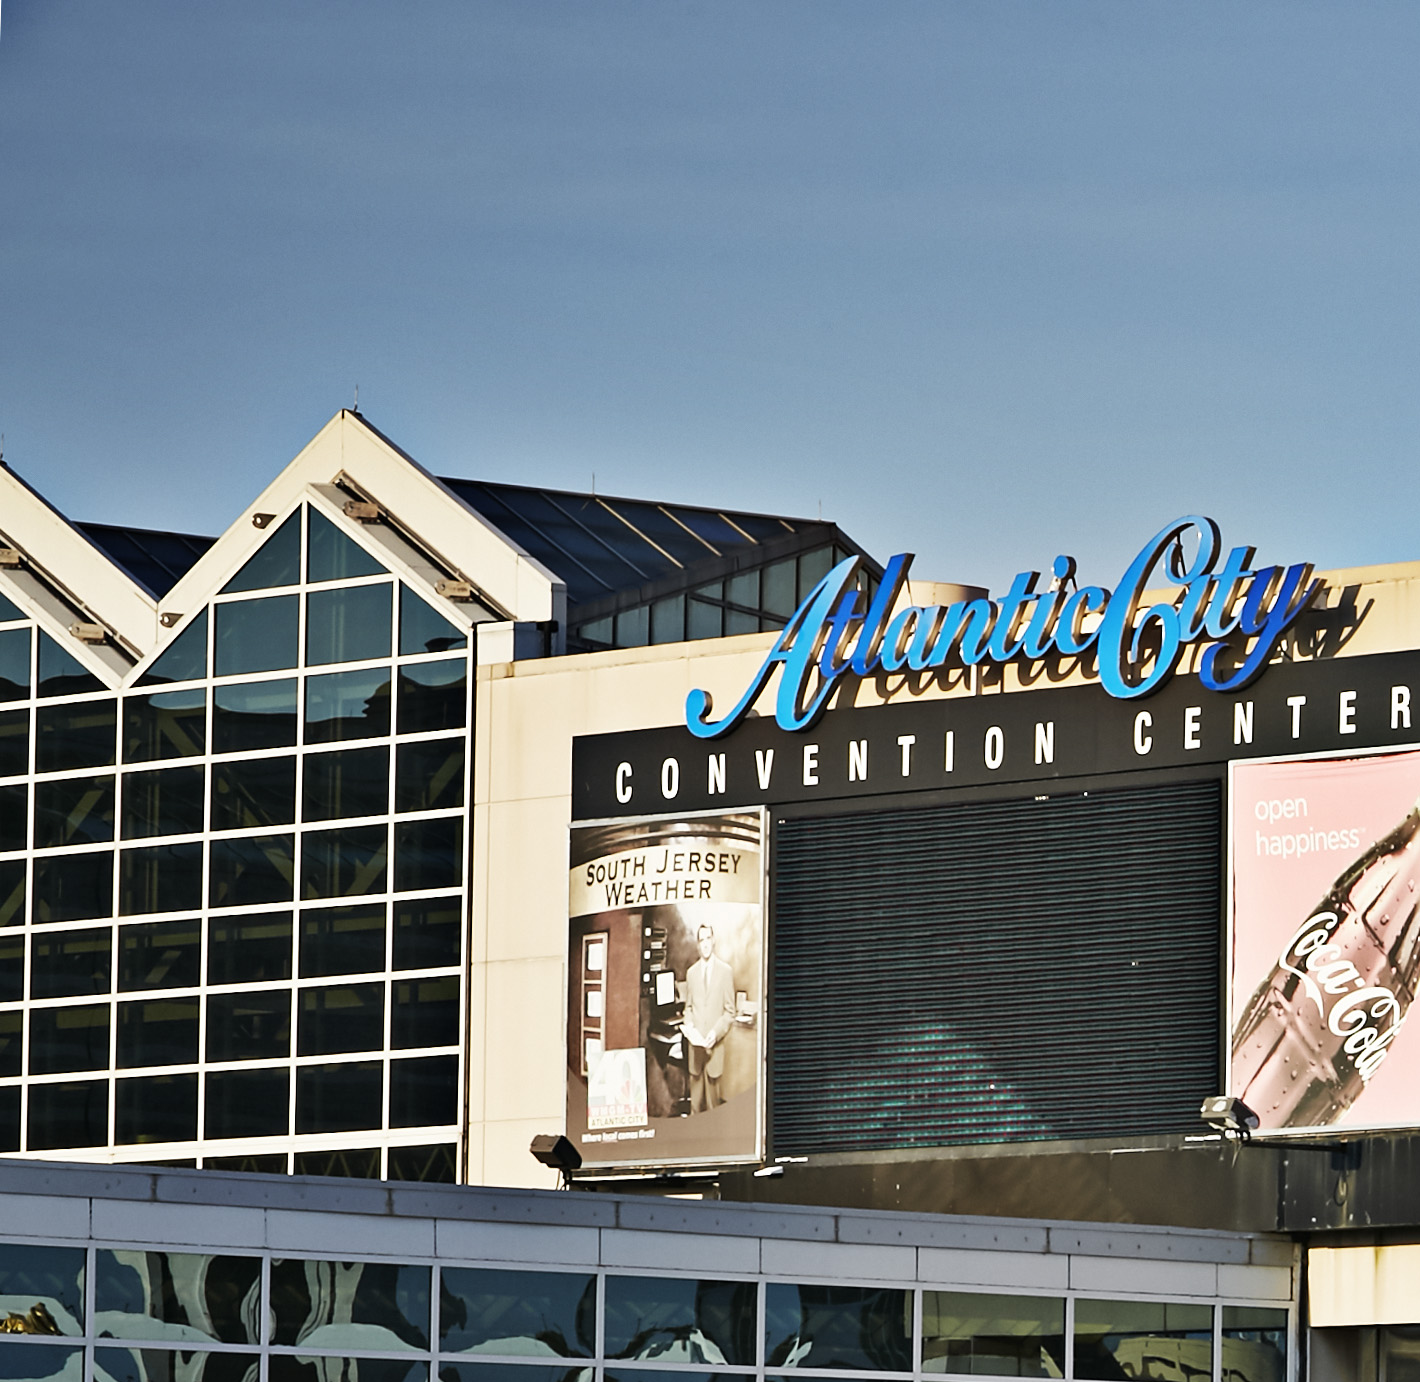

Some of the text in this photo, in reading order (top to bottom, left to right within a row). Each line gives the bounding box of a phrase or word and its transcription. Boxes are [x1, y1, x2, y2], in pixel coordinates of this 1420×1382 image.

[685, 514, 1322, 739] Atlantic City
[615, 685, 1412, 803] CONVENTION CENTER
[1255, 797, 1308, 824] open
[1256, 826, 1360, 859] happiness
[586, 849, 741, 887] SOUTH JERSEY
[605, 879, 712, 907] WEATHER
[1279, 911, 1406, 1086] Coca-Cola
